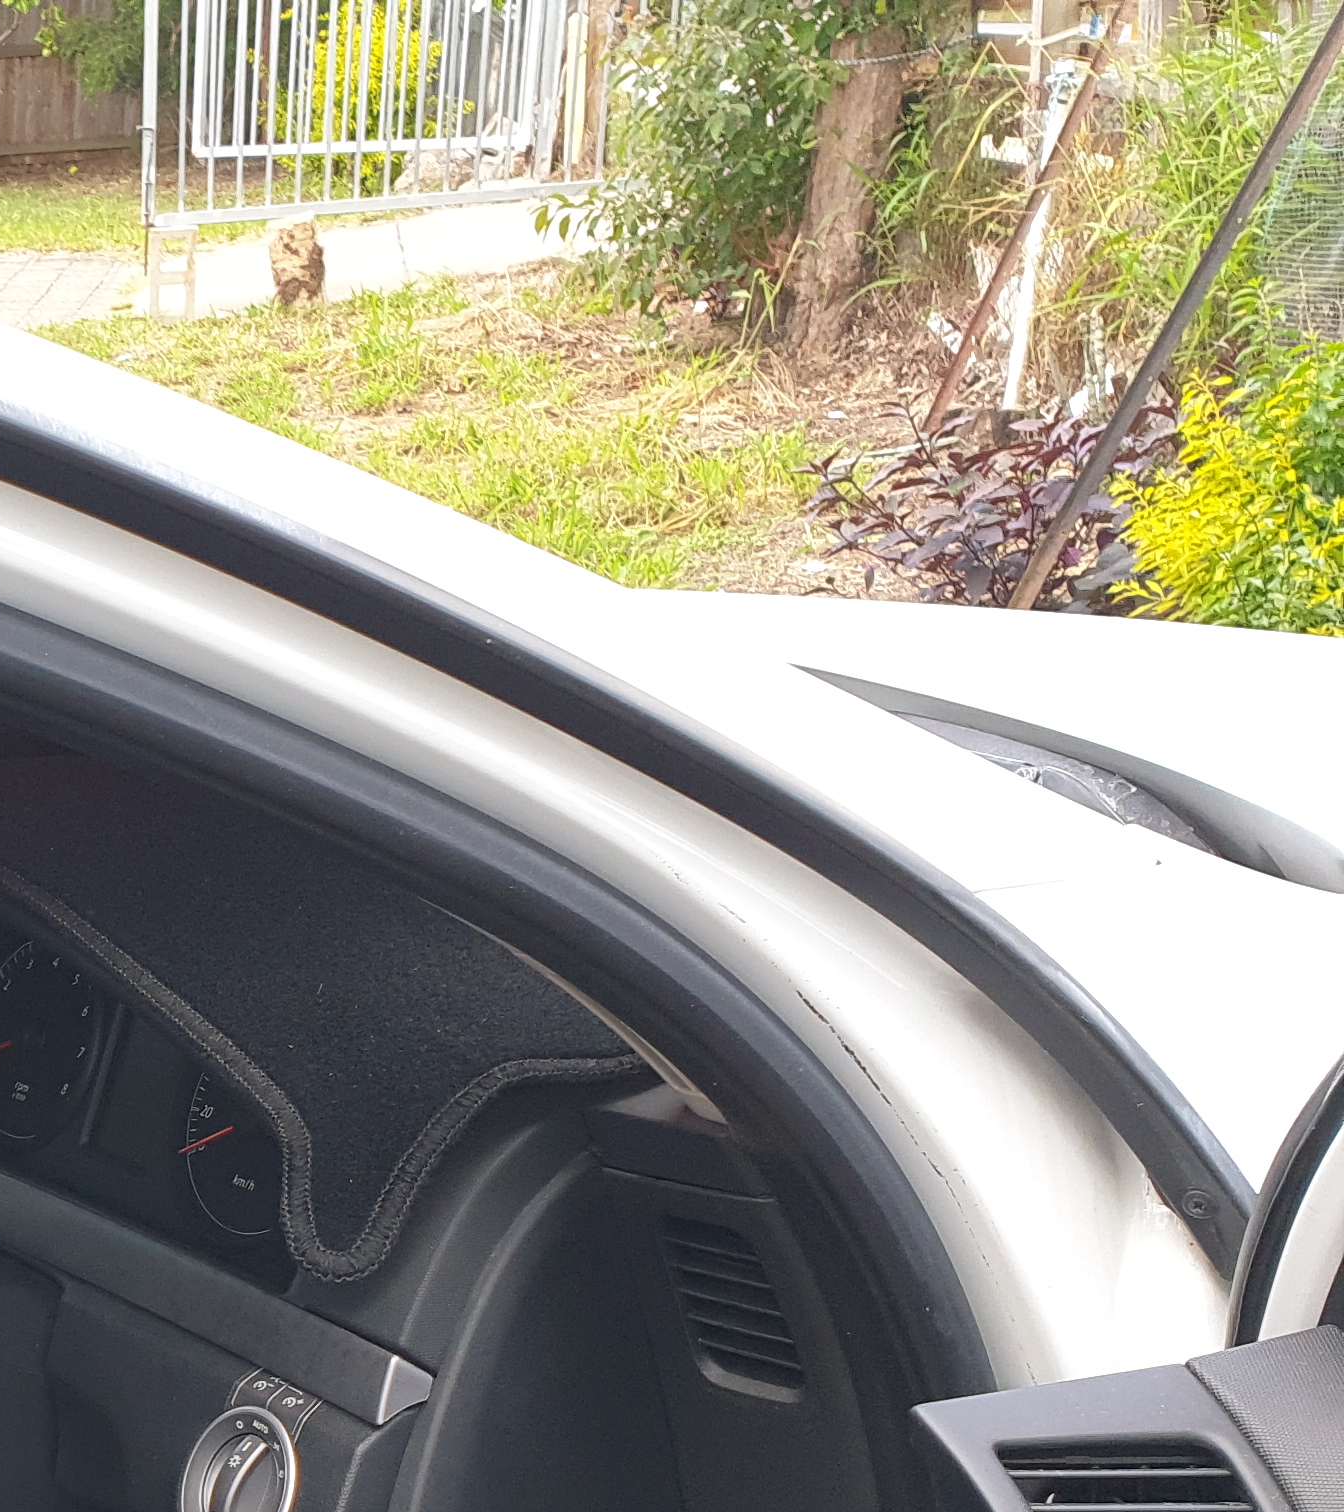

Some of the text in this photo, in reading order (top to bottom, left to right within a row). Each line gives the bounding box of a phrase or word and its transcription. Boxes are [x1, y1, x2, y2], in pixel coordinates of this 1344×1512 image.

[52, 957, 60, 968] 4
[72, 973, 81, 986] 5
[81, 1005, 90, 1017] 6
[76, 1046, 86, 1059] 7
[60, 1083, 69, 1095] 8
[199, 1104, 214, 1119] 20
[232, 1173, 255, 1191] km/h
[252, 1419, 269, 1435] AUTO
